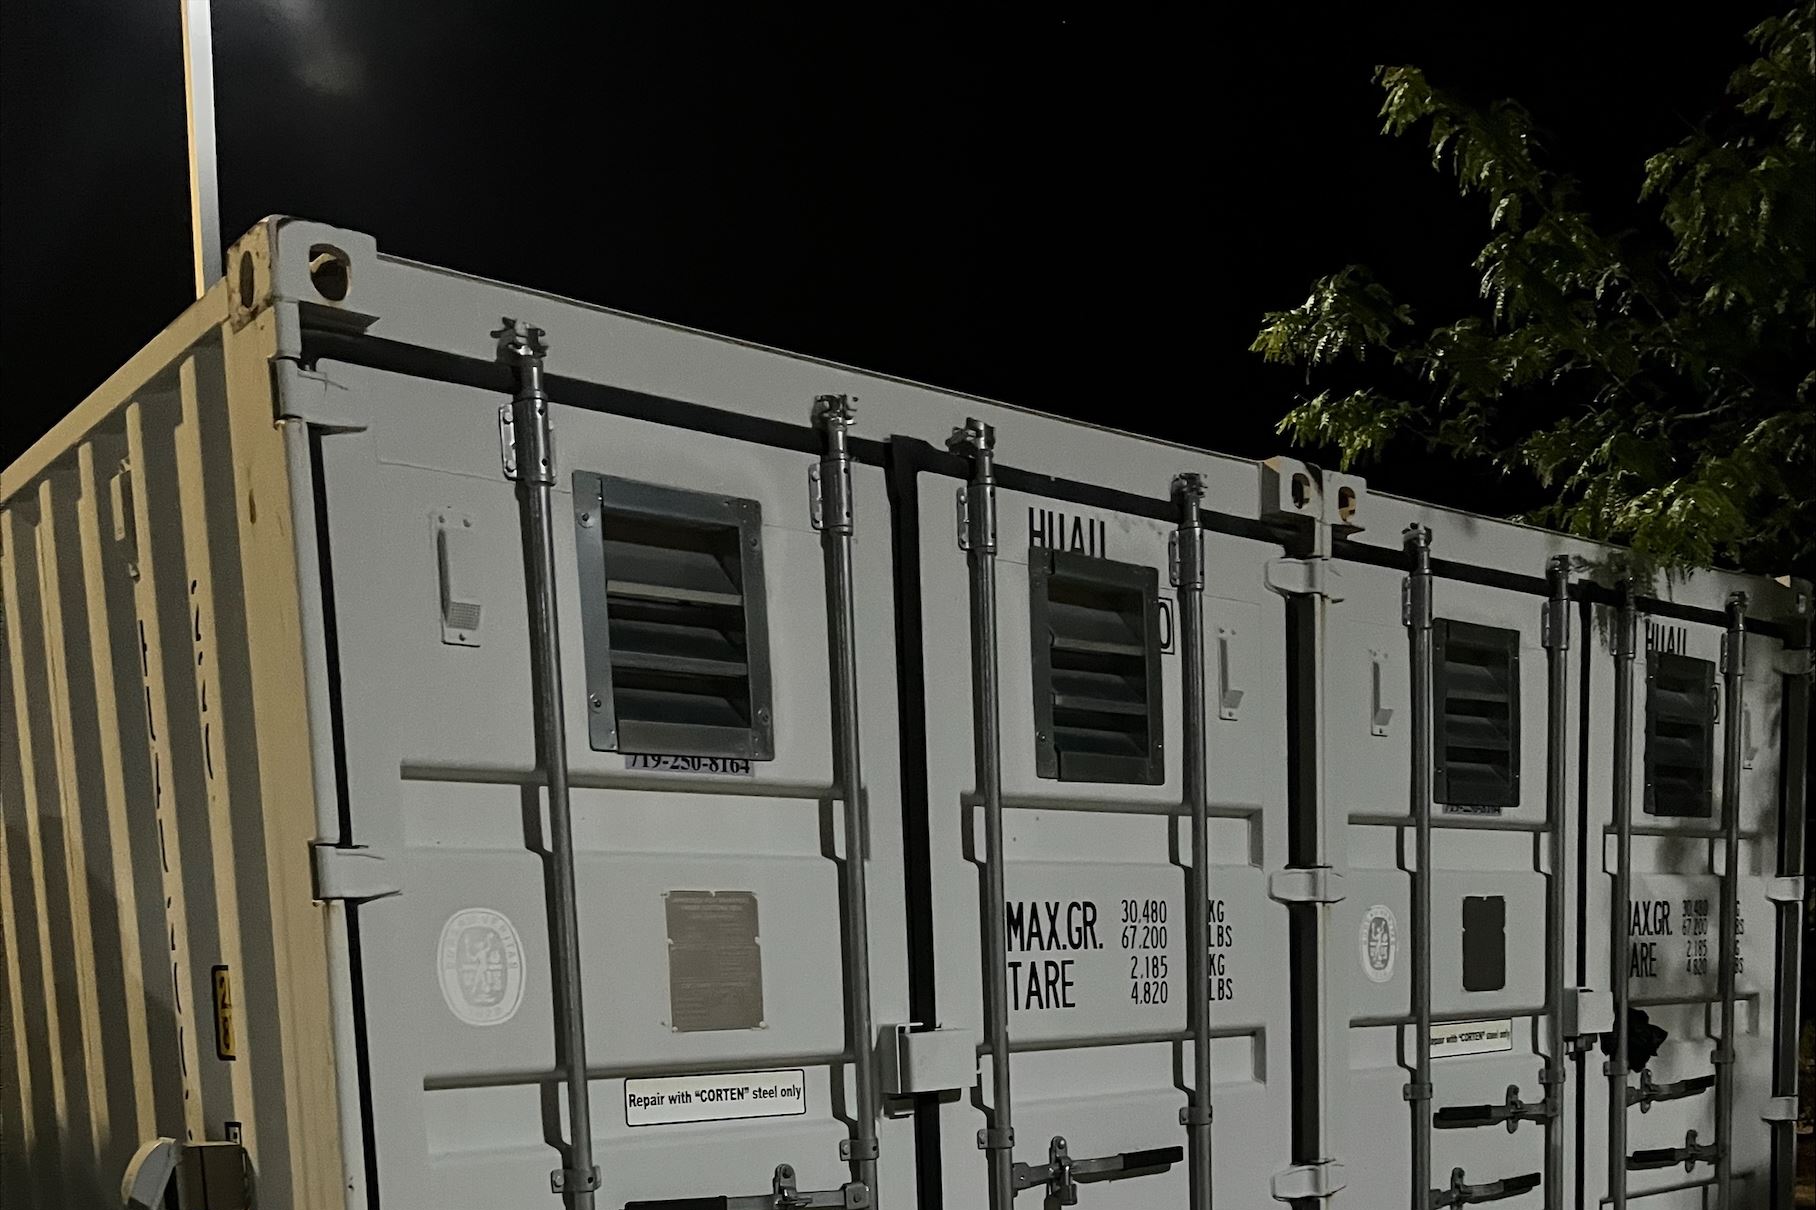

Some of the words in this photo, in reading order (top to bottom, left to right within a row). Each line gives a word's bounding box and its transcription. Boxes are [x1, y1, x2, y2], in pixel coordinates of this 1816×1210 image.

[1006, 901, 1104, 952] MAX.GR.
[1121, 900, 1168, 924] 30.480
[1208, 900, 1225, 923] KG
[1629, 900, 1673, 936] AX.GR.
[1121, 926, 1168, 949] 67.200
[1630, 942, 1657, 978] ARE
[1008, 960, 1076, 1011] TARE
[1131, 956, 1168, 979] 2.185
[1209, 954, 1225, 976] KG
[1131, 981, 1168, 1005] 4.820
[628, 1092, 665, 1110] Repair
[668, 1090, 692, 1104] with
[752, 1085, 778, 1099] steel
[780, 1084, 802, 1100] only
